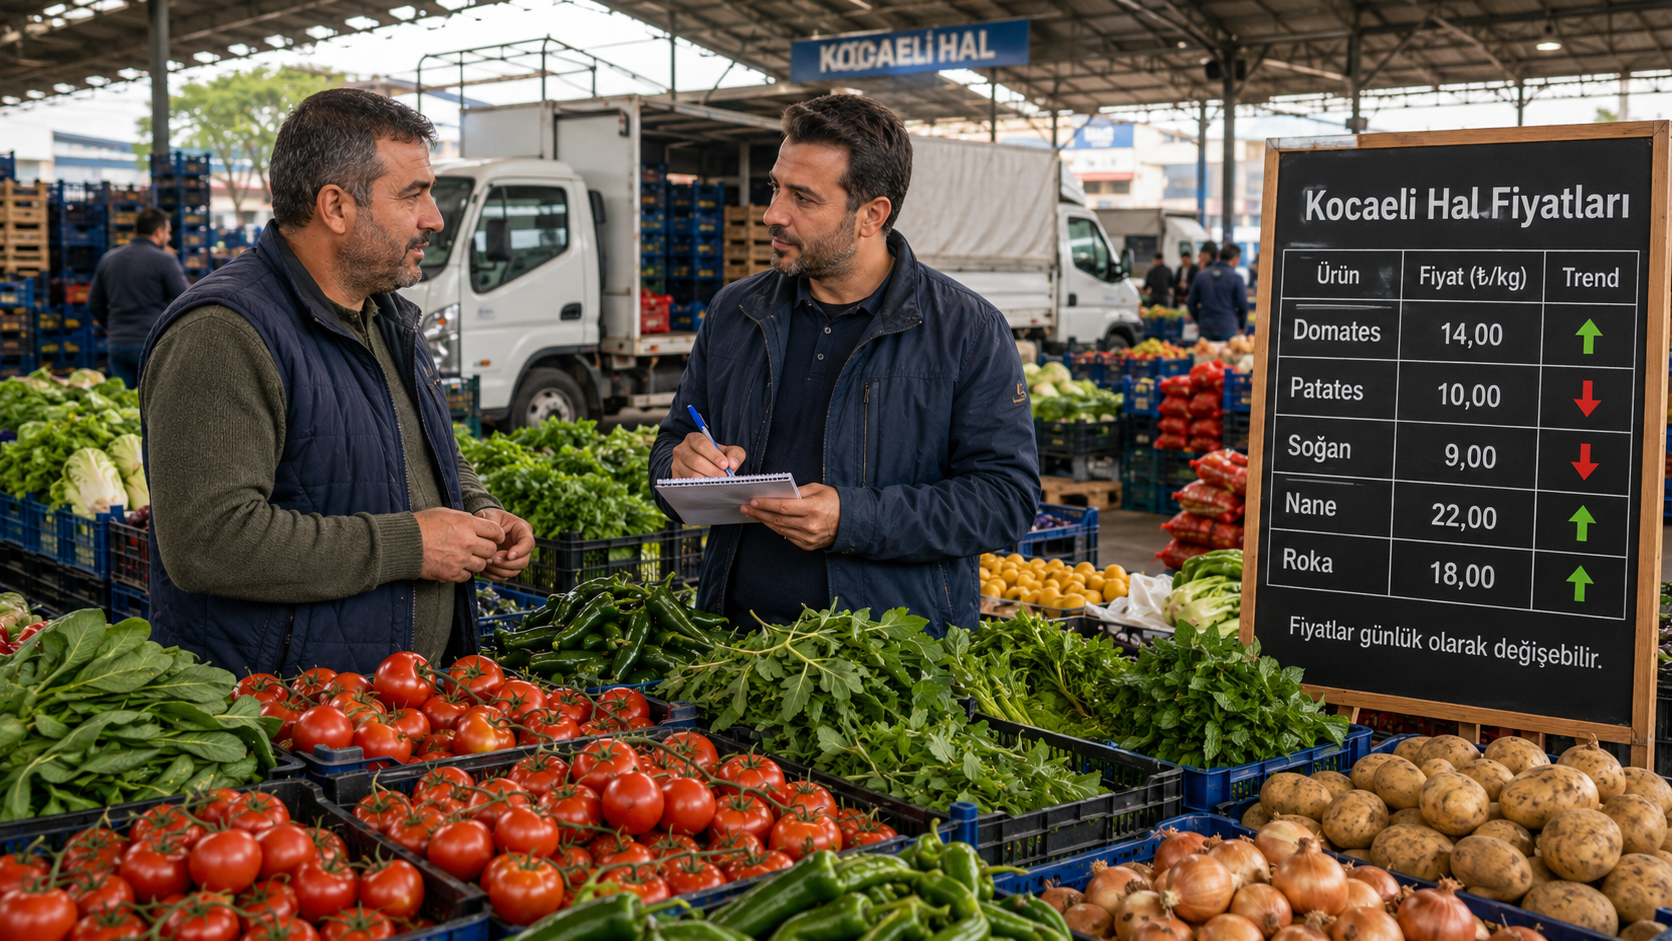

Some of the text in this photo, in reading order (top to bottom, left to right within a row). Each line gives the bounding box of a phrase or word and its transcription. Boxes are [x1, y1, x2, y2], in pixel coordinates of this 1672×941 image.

[937, 29, 997, 64] HAL
[1305, 184, 1630, 229] Kocaeli Hal Fiyatları
[1317, 261, 1620, 292] Ürün Fiyat (₺/kg) Trend
[1293, 318, 1503, 349] Domates 14,00
[1290, 376, 1501, 411] Patates 10,00
[1287, 434, 1497, 471] Soğan 9,00
[1285, 491, 1497, 532] Nane 22,00
[1282, 547, 1495, 591] Roka 18,00
[1289, 615, 1602, 669] Fiyatlar günlük olarak değişebilir.
